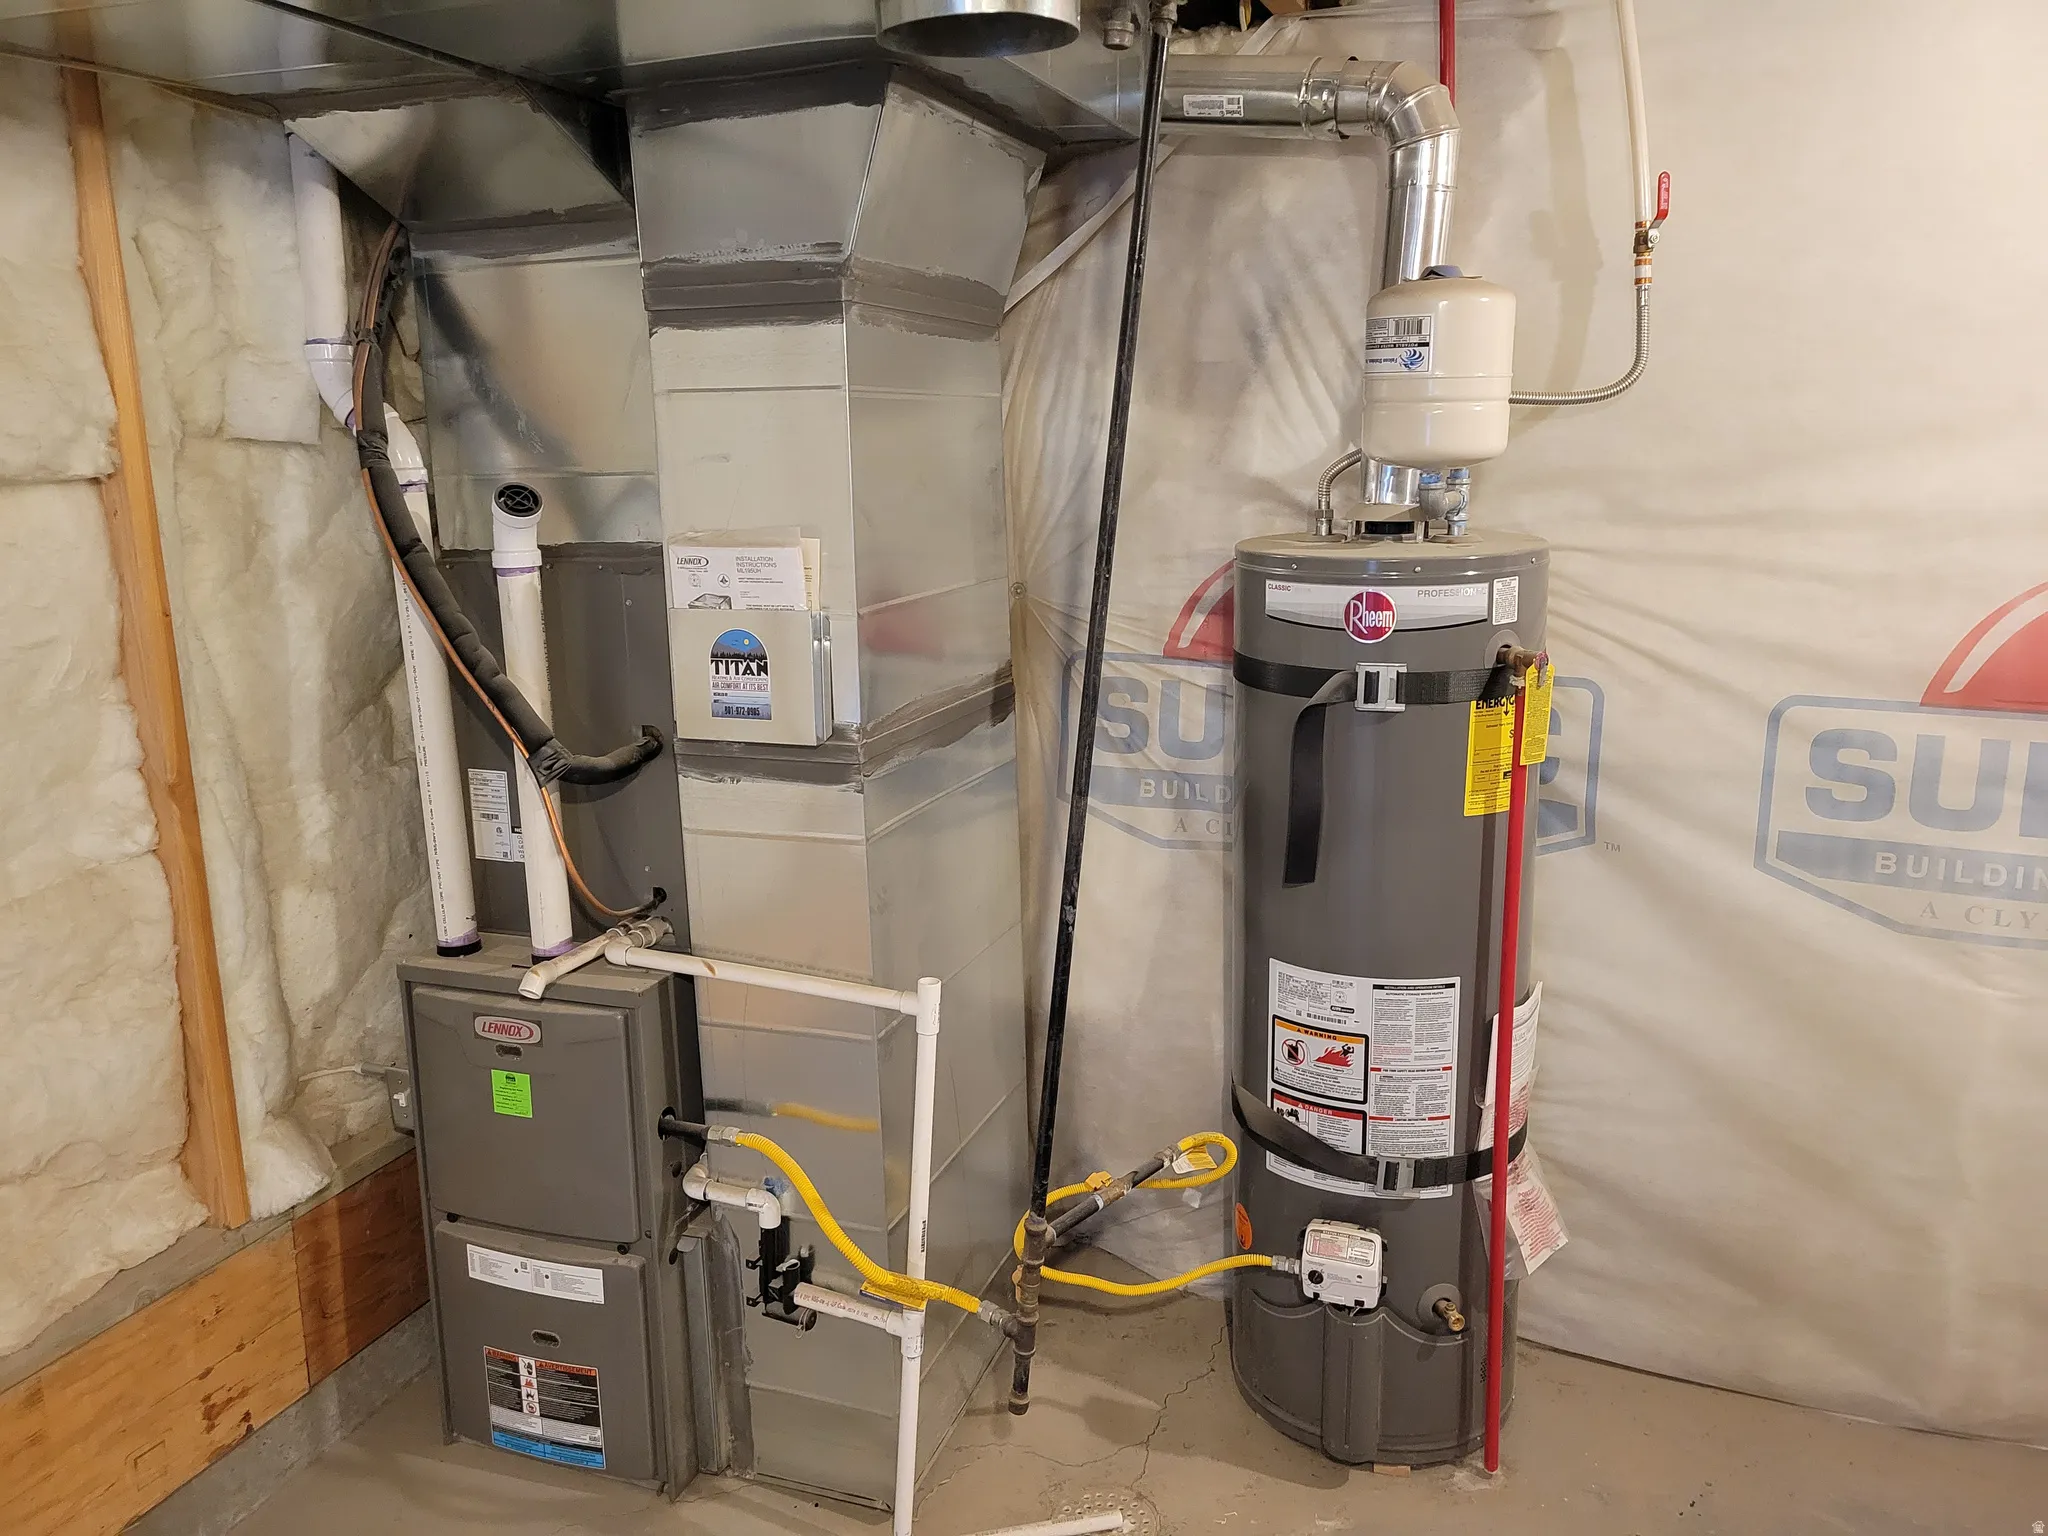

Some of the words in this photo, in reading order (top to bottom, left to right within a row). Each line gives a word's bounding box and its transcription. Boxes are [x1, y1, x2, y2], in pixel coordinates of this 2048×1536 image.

[676, 557, 703, 566] LENNOX
[1267, 583, 1292, 592] CLASSIC
[1350, 593, 1394, 635] Rheem
[710, 659, 769, 677] TITAN
[1604, 841, 1621, 853] TM
[1919, 901, 1940, 919] A
[481, 1020, 524, 1038] LENNOX
[1304, 1029, 1337, 1041] WARNING
[1304, 1103, 1333, 1115] DANGER
